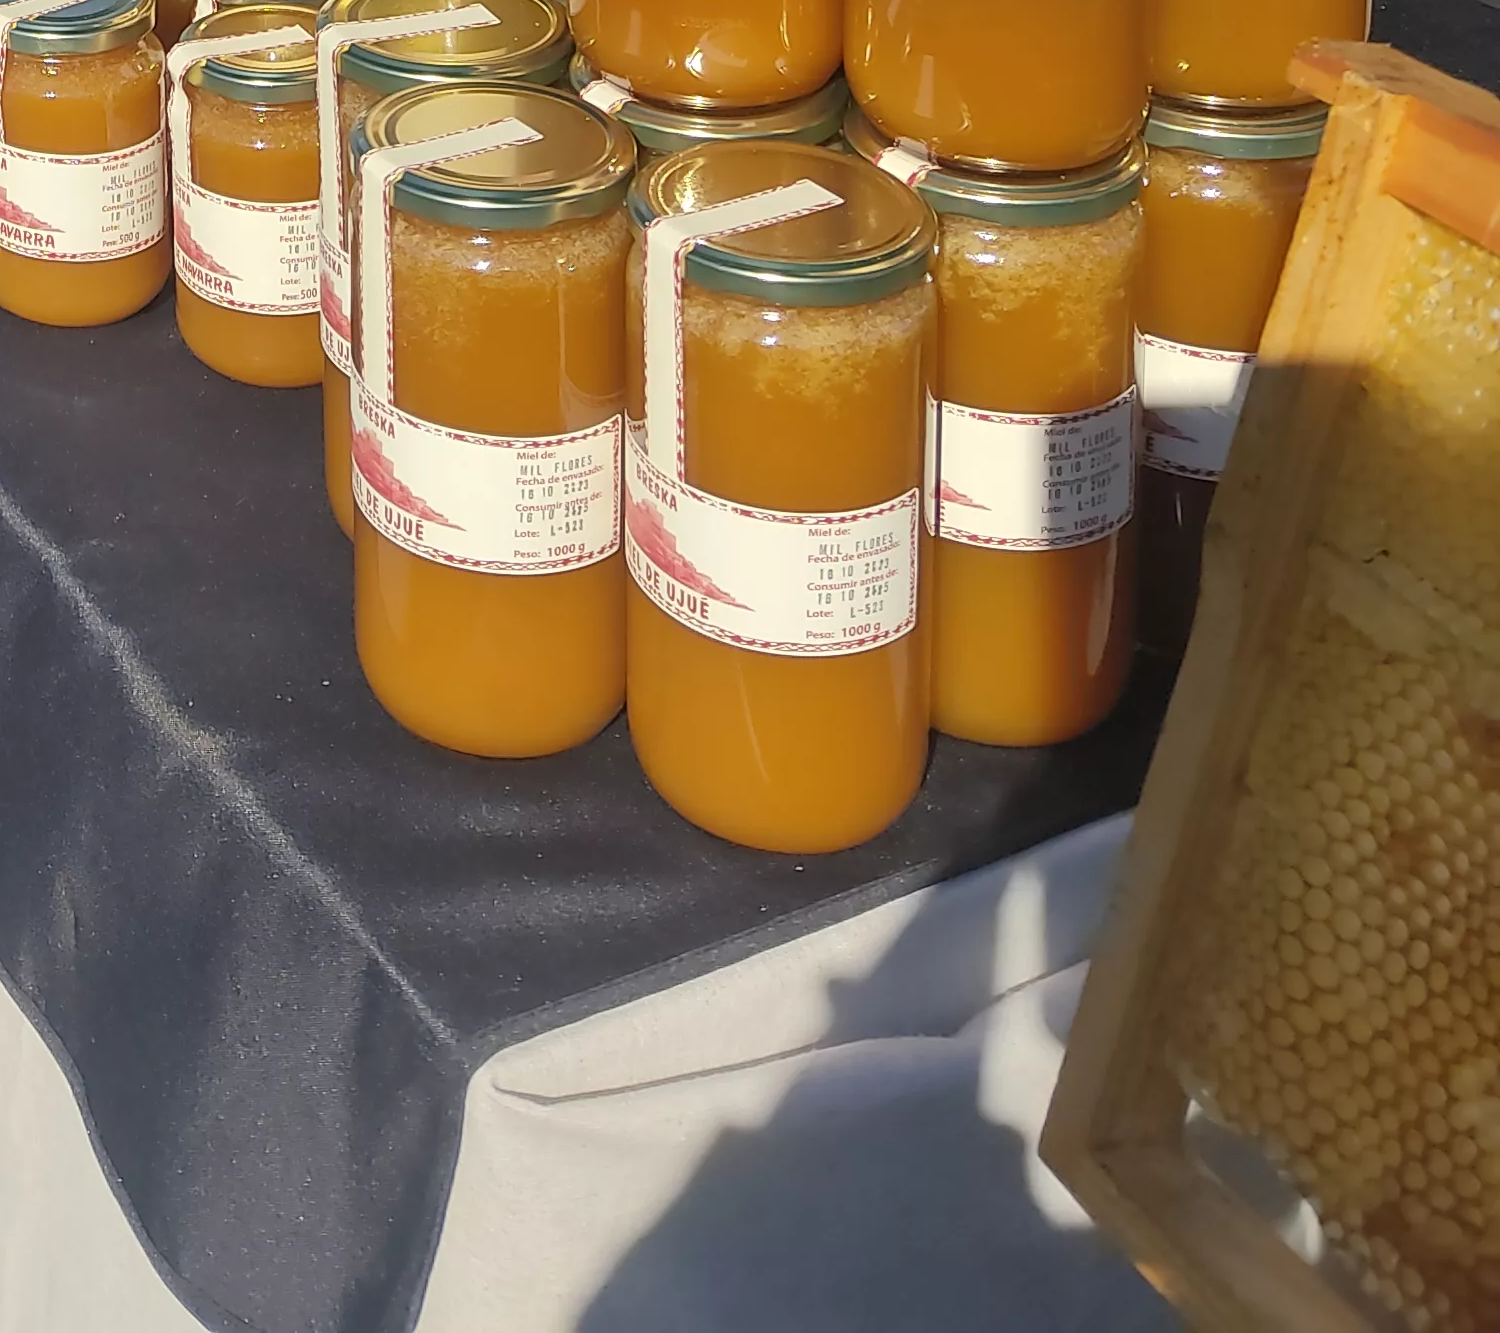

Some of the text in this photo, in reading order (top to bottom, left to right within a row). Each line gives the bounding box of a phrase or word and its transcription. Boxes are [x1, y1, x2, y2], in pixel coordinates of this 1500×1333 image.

[279, 215, 298, 223] Miel
[288, 225, 306, 235] MIL
[120, 232, 140, 244] 500 g
[279, 234, 316, 242] Fecha de
[182, 256, 234, 296] NAVARRA
[301, 288, 318, 299] 500
[358, 393, 396, 439] BRESKA
[517, 451, 556, 460] Miel de:
[520, 455, 593, 476] MIL FLORES
[516, 464, 604, 485] Fecha de envasado:
[542, 486, 553, 497] 10
[636, 462, 678, 513] BRESKA
[515, 491, 603, 512] Consumir de:
[365, 492, 424, 541] DE UJUÉ
[514, 529, 540, 537] Lote:
[808, 528, 851, 537] Miel de:
[514, 543, 585, 558] Peso: 1000 g
[819, 532, 894, 555] MIL FLORES
[808, 555, 839, 563] Fecha
[842, 553, 855, 561] de
[842, 565, 853, 577] 10
[807, 569, 898, 591] Consumir antes de:
[645, 565, 710, 621] DE UJUÉ
[842, 590, 854, 601] 10
[807, 600, 884, 618] Lote: L-523
[806, 622, 881, 639] Peso: 1000 g
